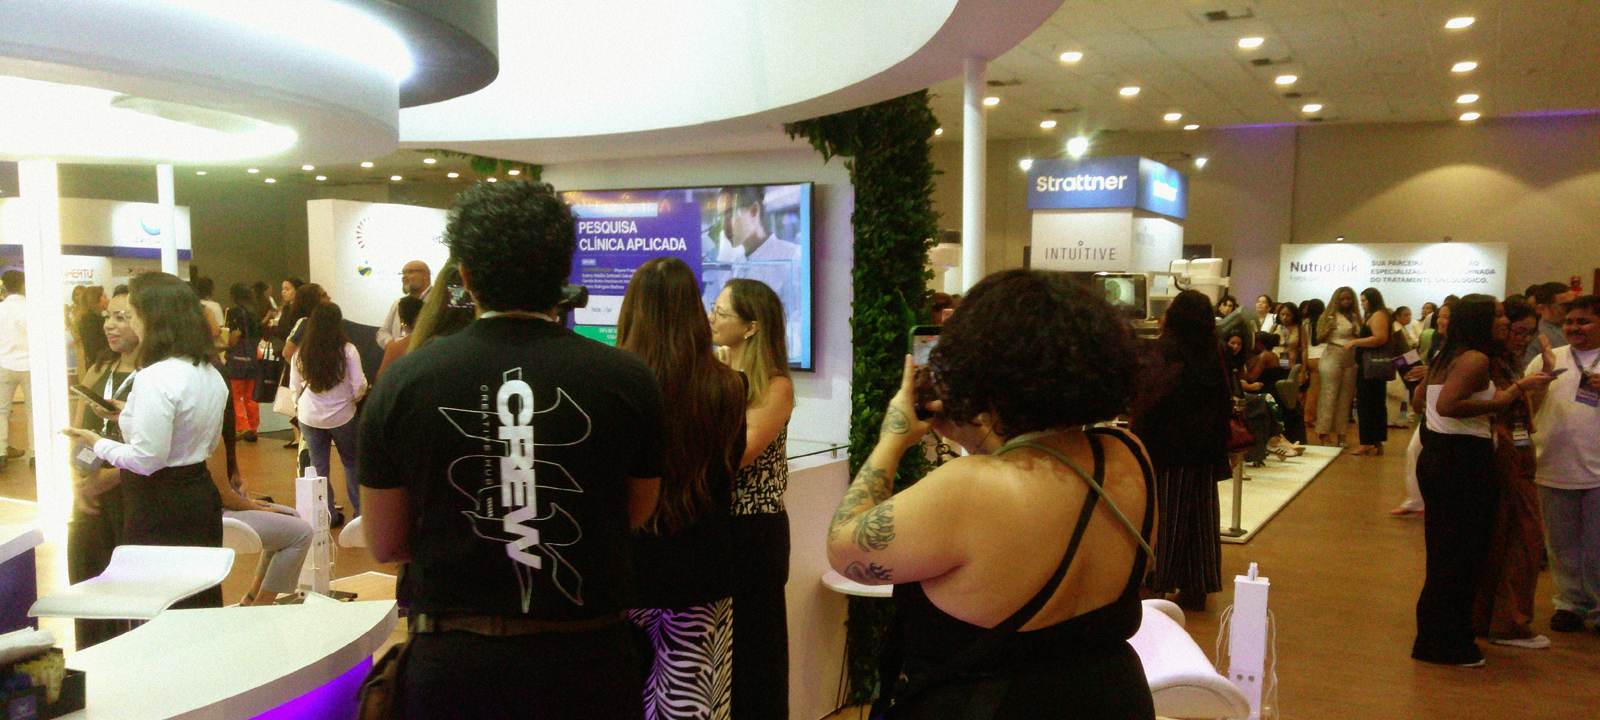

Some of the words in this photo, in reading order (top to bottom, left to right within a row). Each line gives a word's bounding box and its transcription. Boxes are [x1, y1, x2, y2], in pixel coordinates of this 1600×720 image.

[1036, 174, 1128, 192] Strattner
[578, 221, 638, 234] PESQUISA
[579, 236, 625, 251] CLÍNICA
[626, 237, 687, 251] APLICADA
[1045, 241, 1117, 260] INTUITIVE
[480, 384, 492, 452] CREATIVE
[484, 459, 493, 486] HUB
[496, 380, 542, 569] CREW
